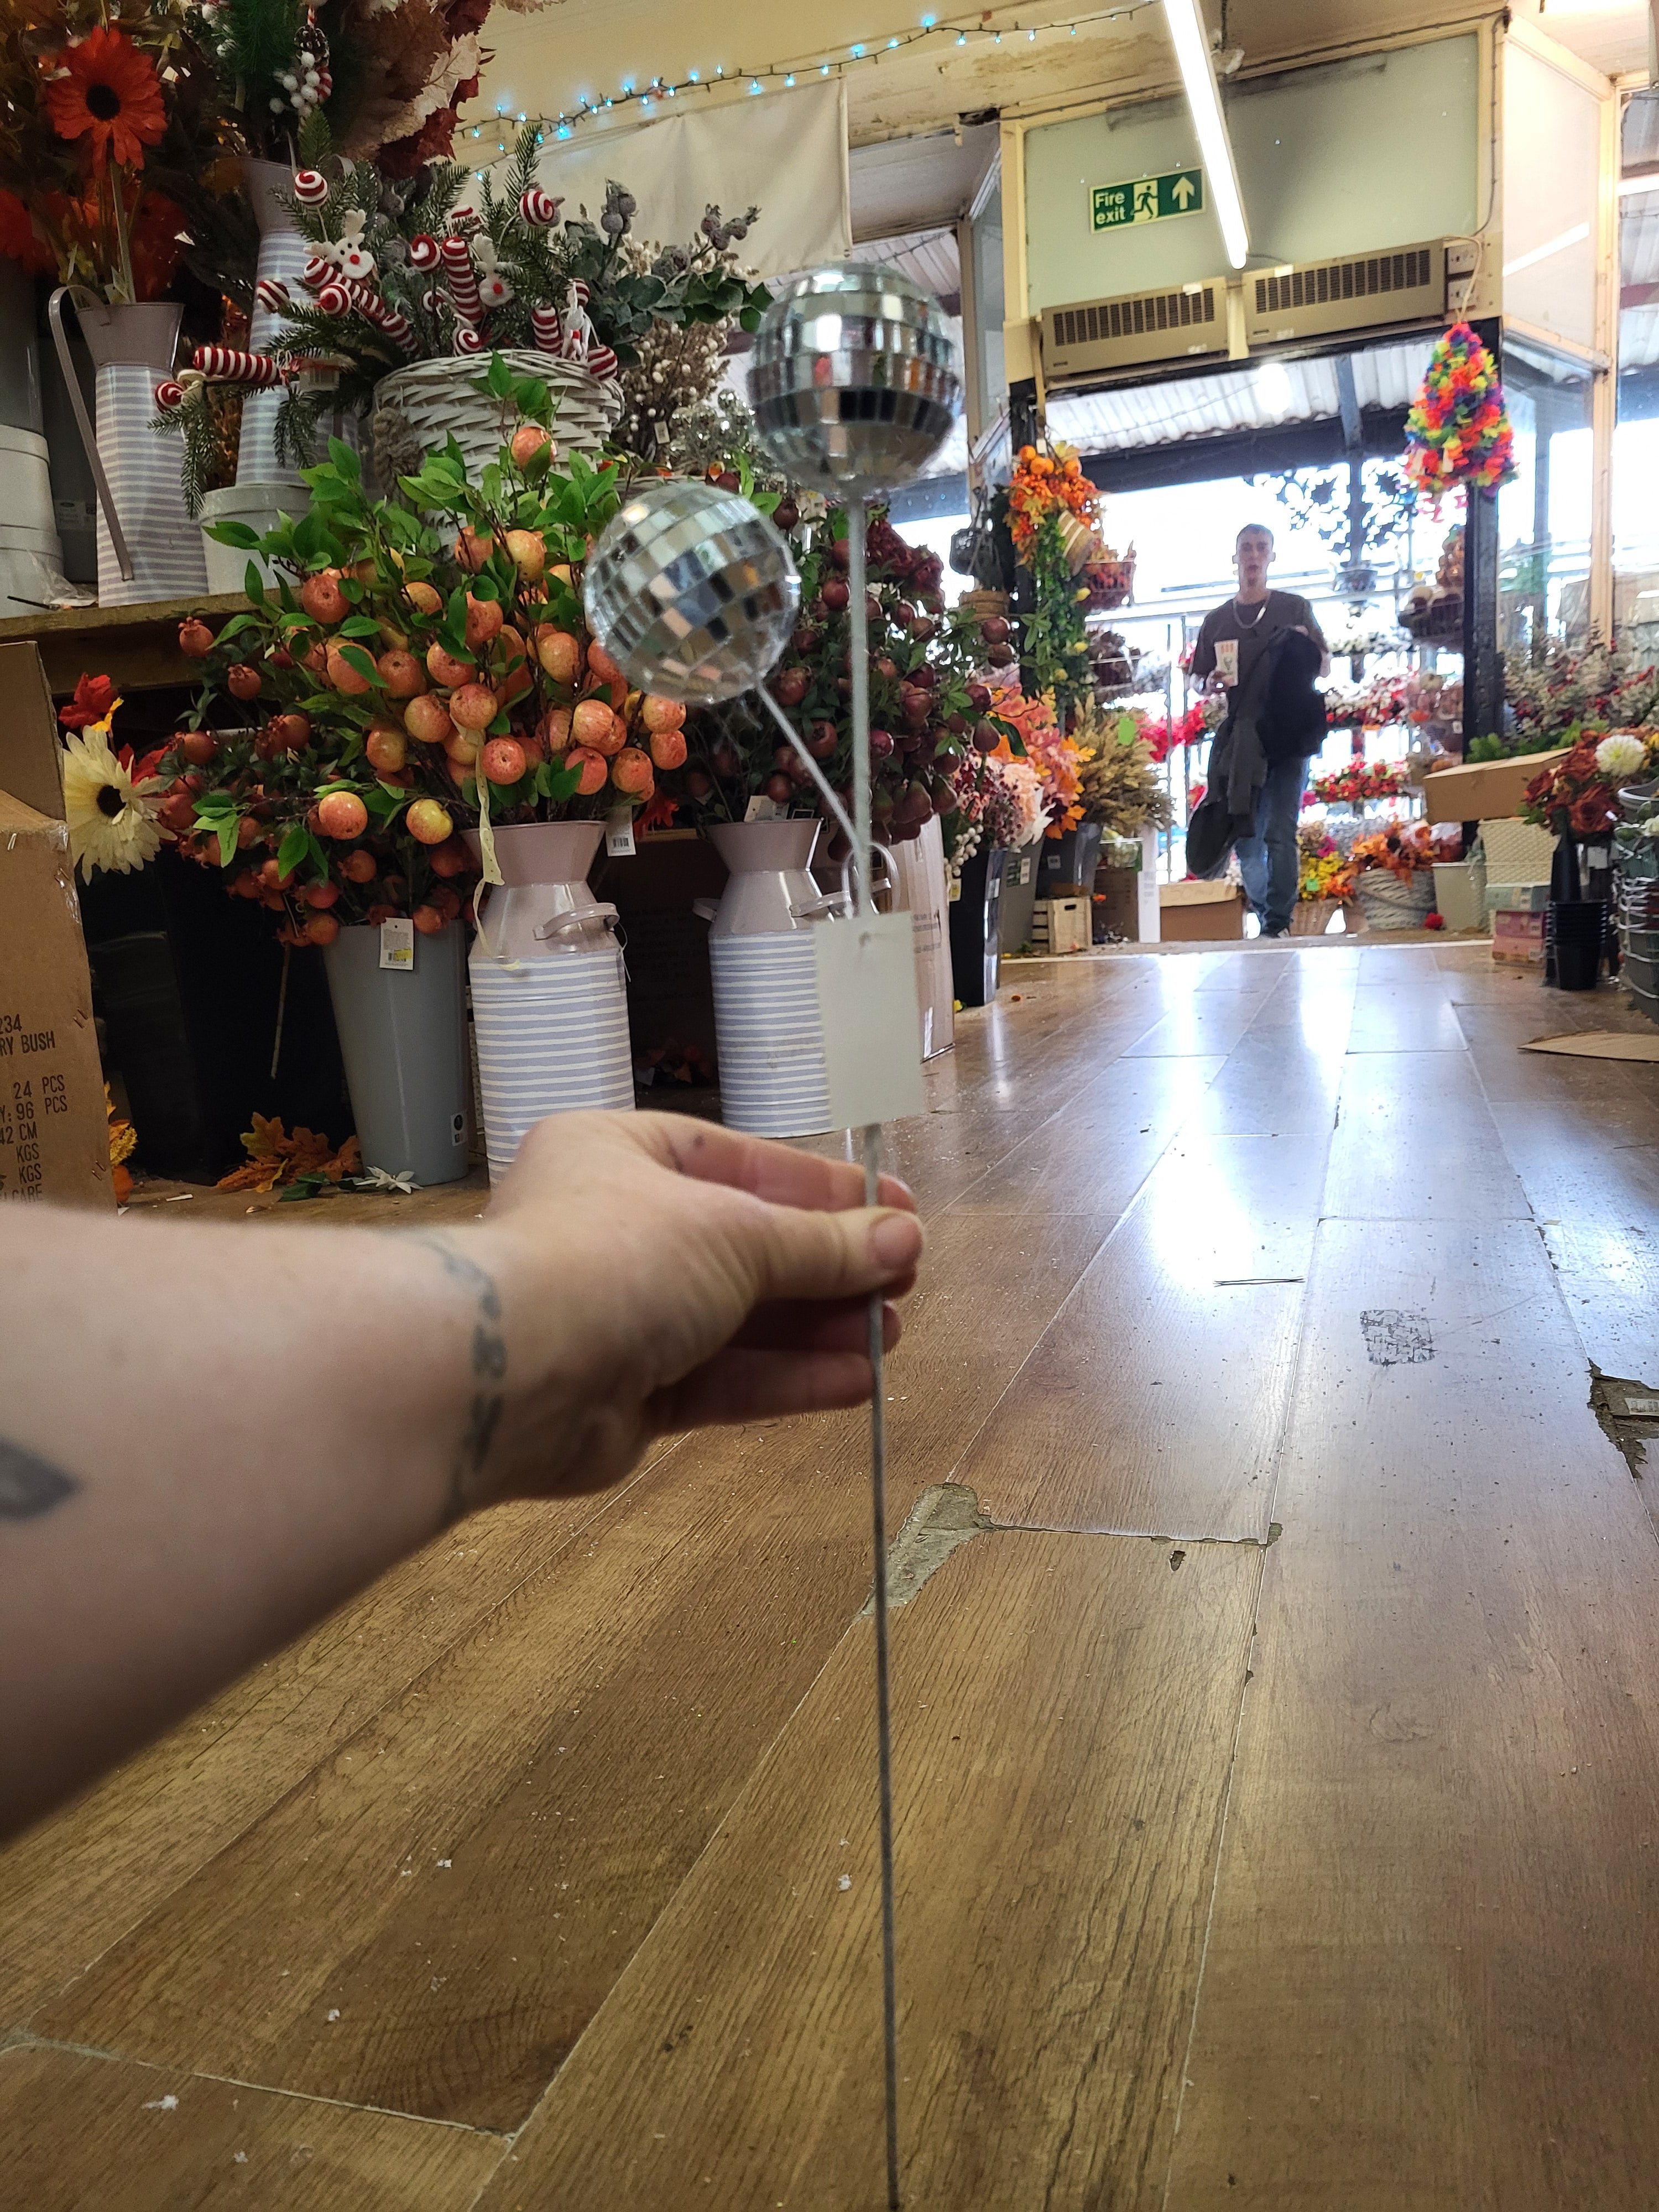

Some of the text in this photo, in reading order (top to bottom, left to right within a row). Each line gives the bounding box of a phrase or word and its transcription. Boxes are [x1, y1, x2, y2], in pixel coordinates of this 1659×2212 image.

[1095, 191, 1125, 208] Fire
[1095, 206, 1126, 225] exit
[21, 1030, 55, 1053] BUSH
[13, 1074, 65, 1099] 24 PCS
[16, 1101, 34, 1120] 96
[45, 1095, 67, 1115] PCS
[19, 1121, 38, 1141] CM
[16, 1143, 39, 1164] KGS
[19, 1163, 41, 1184] KGS
